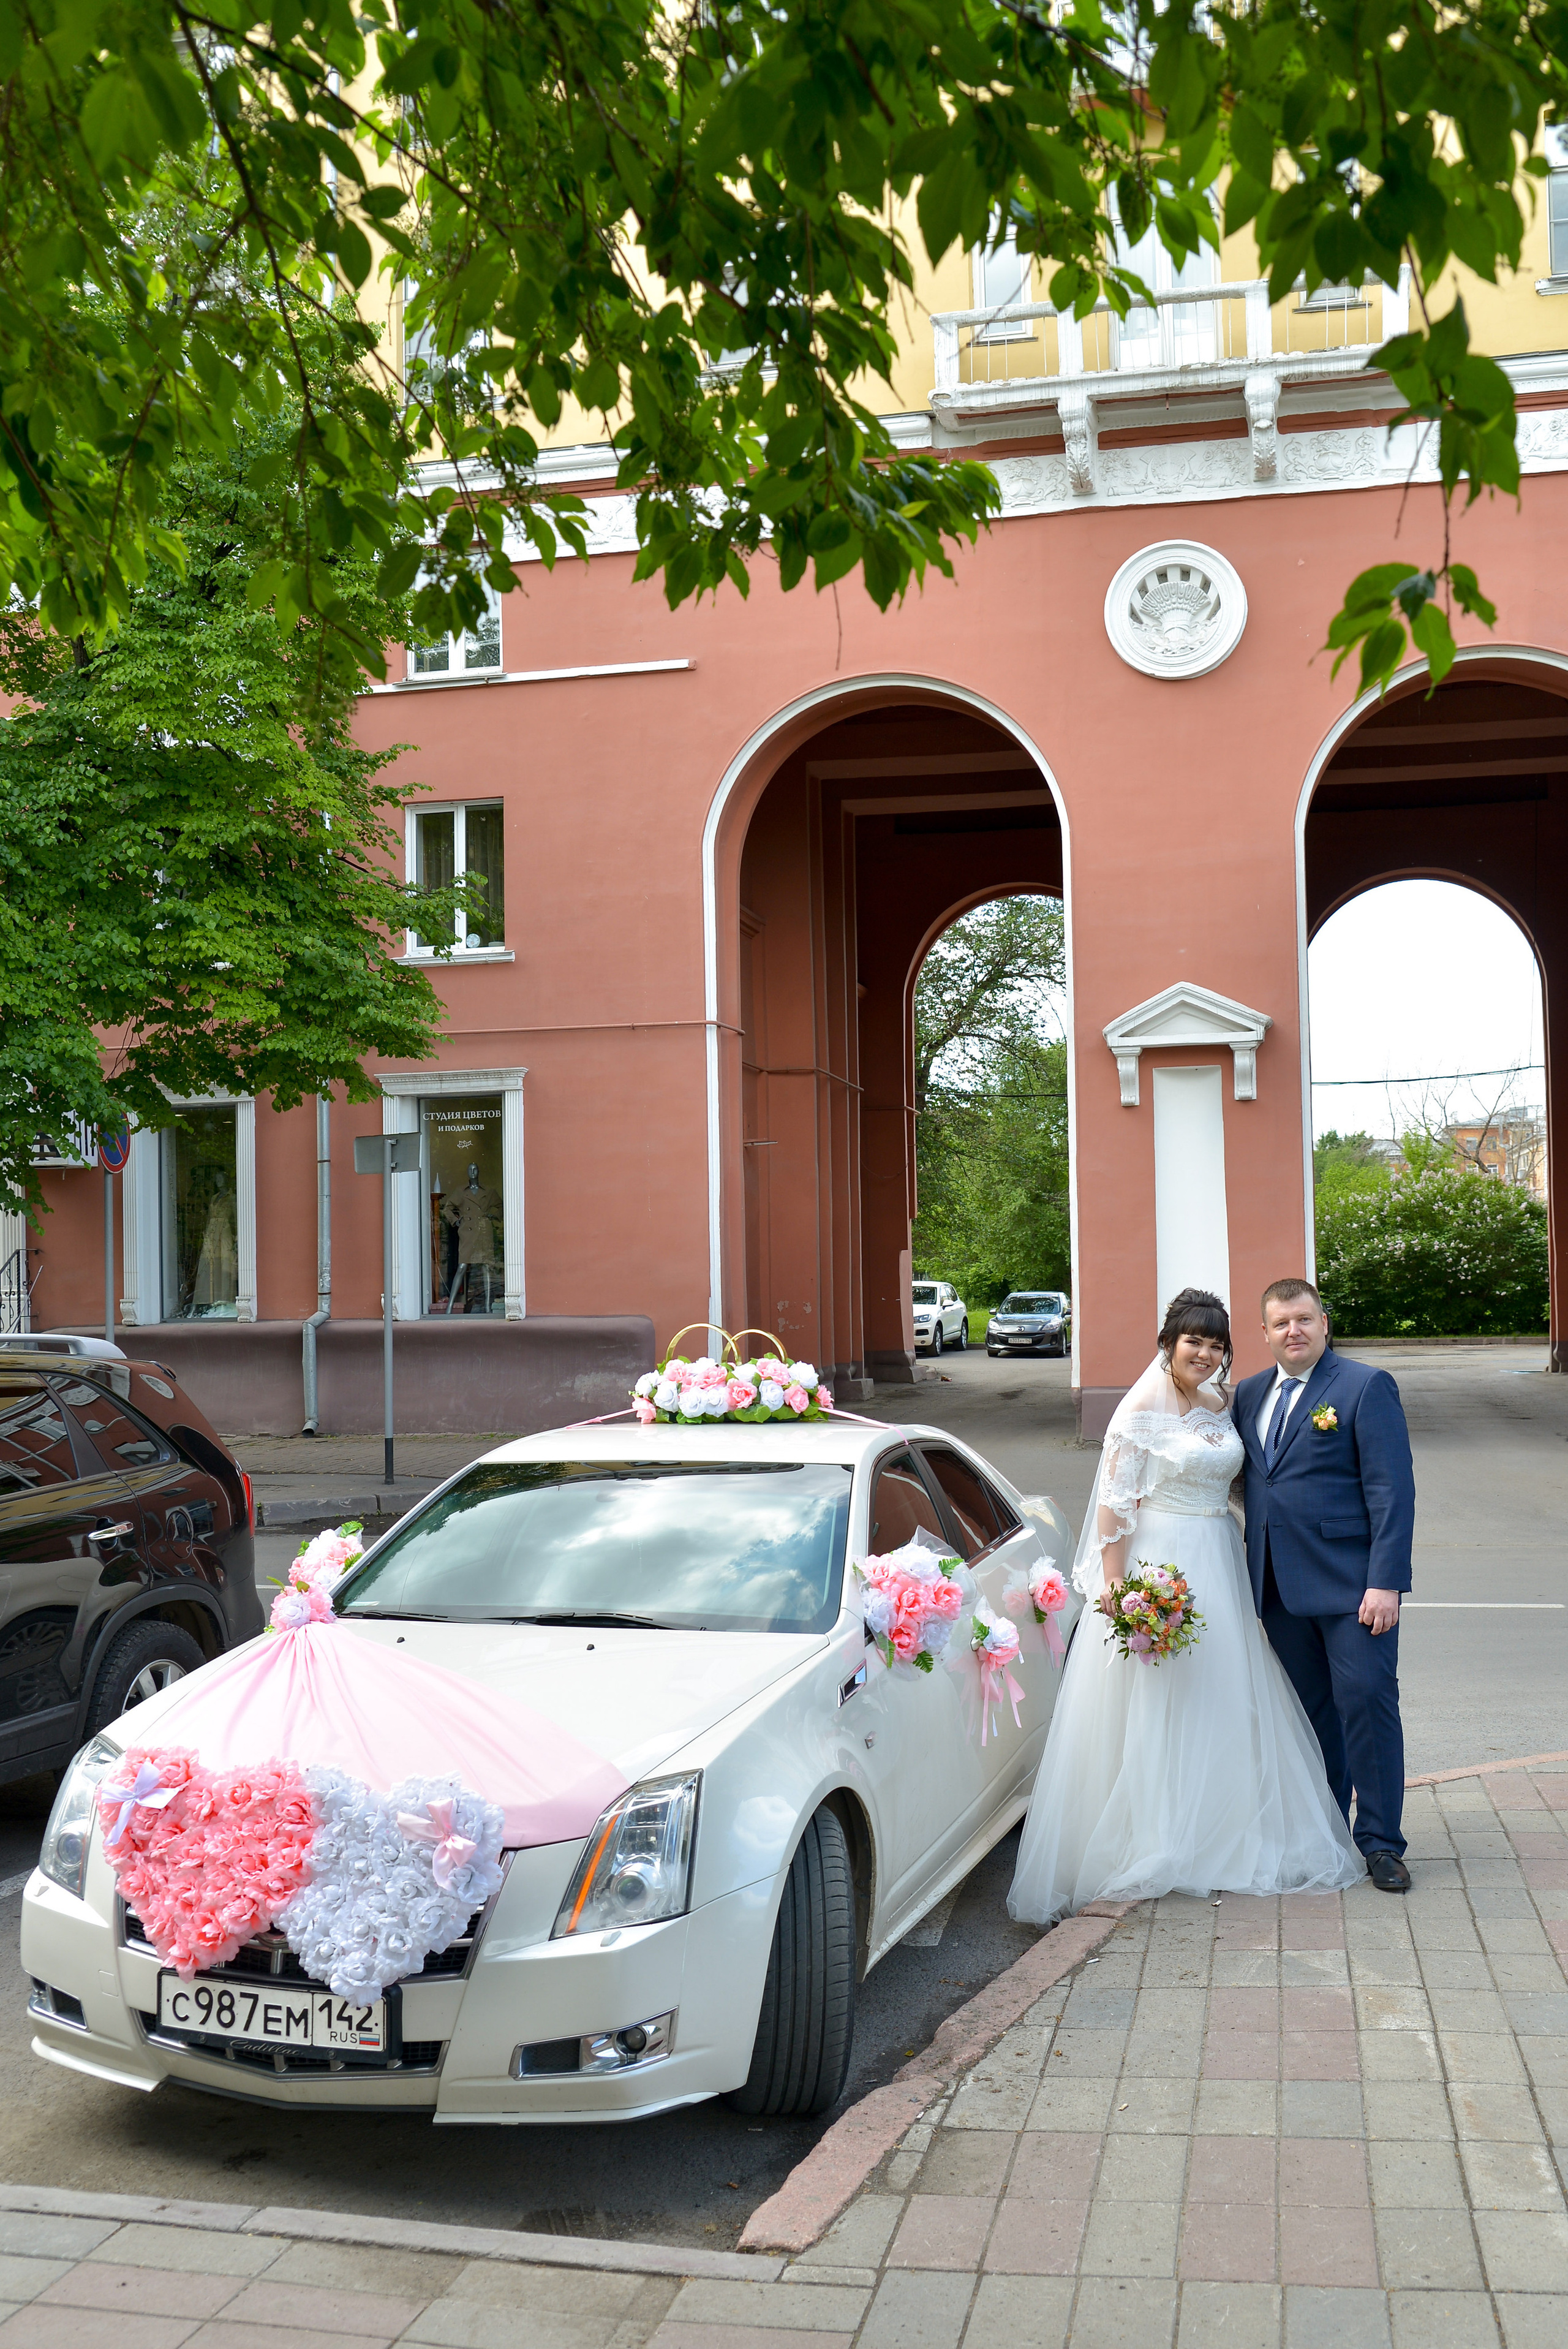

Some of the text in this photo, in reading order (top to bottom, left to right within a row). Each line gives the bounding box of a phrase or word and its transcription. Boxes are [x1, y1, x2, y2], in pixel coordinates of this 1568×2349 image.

[423, 1110, 501, 1121] СТУДИЯ ЦВЕТОВ
[318, 1999, 372, 2032] 142
[330, 2031, 357, 2043] RUS
[230, 2039, 300, 2056] Cadillac
